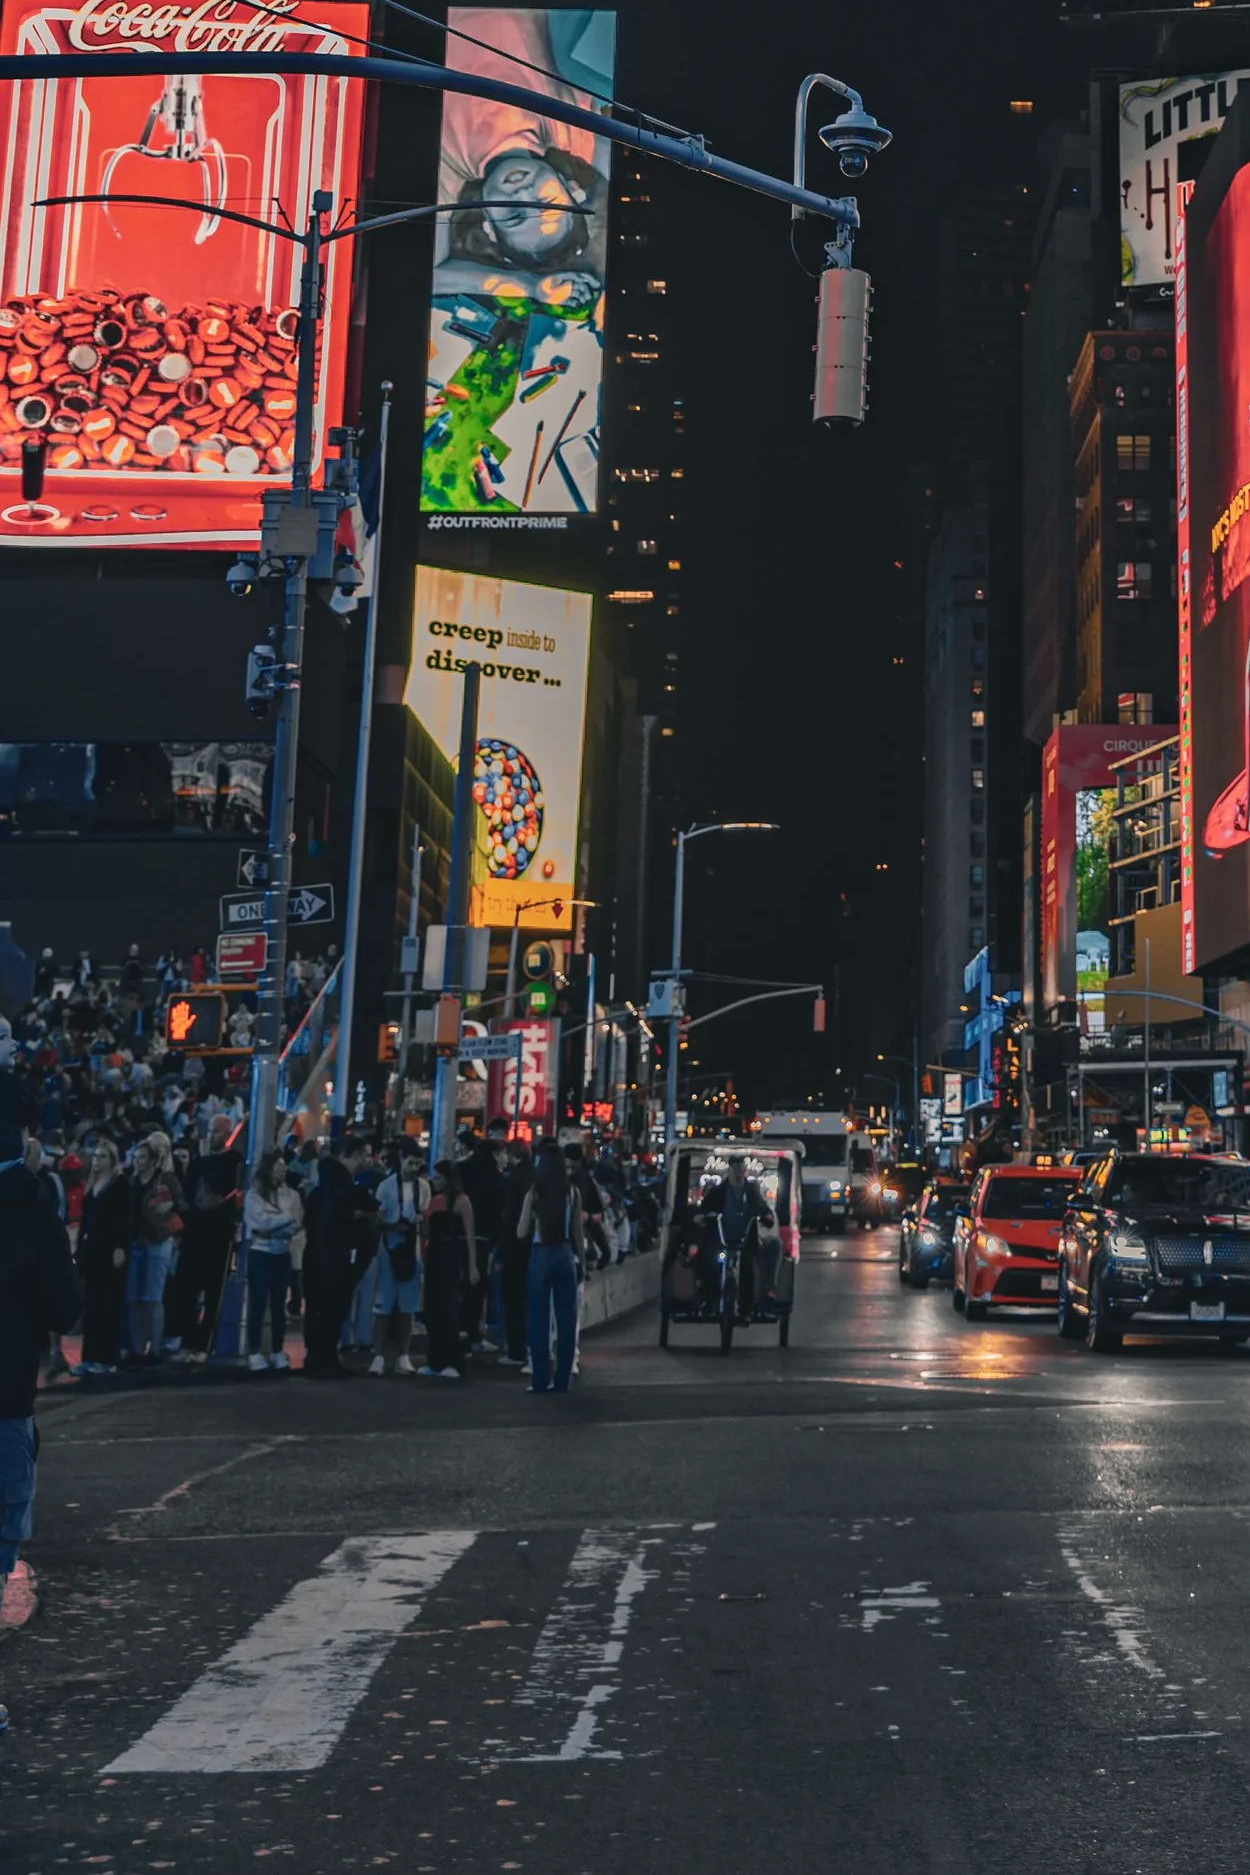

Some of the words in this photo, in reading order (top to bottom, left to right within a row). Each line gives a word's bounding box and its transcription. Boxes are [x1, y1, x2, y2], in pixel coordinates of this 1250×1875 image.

[427, 513, 569, 530] #OUTFRONTPRIME
[428, 619, 504, 650] creep
[506, 626, 542, 652] inside
[542, 633, 557, 654] to
